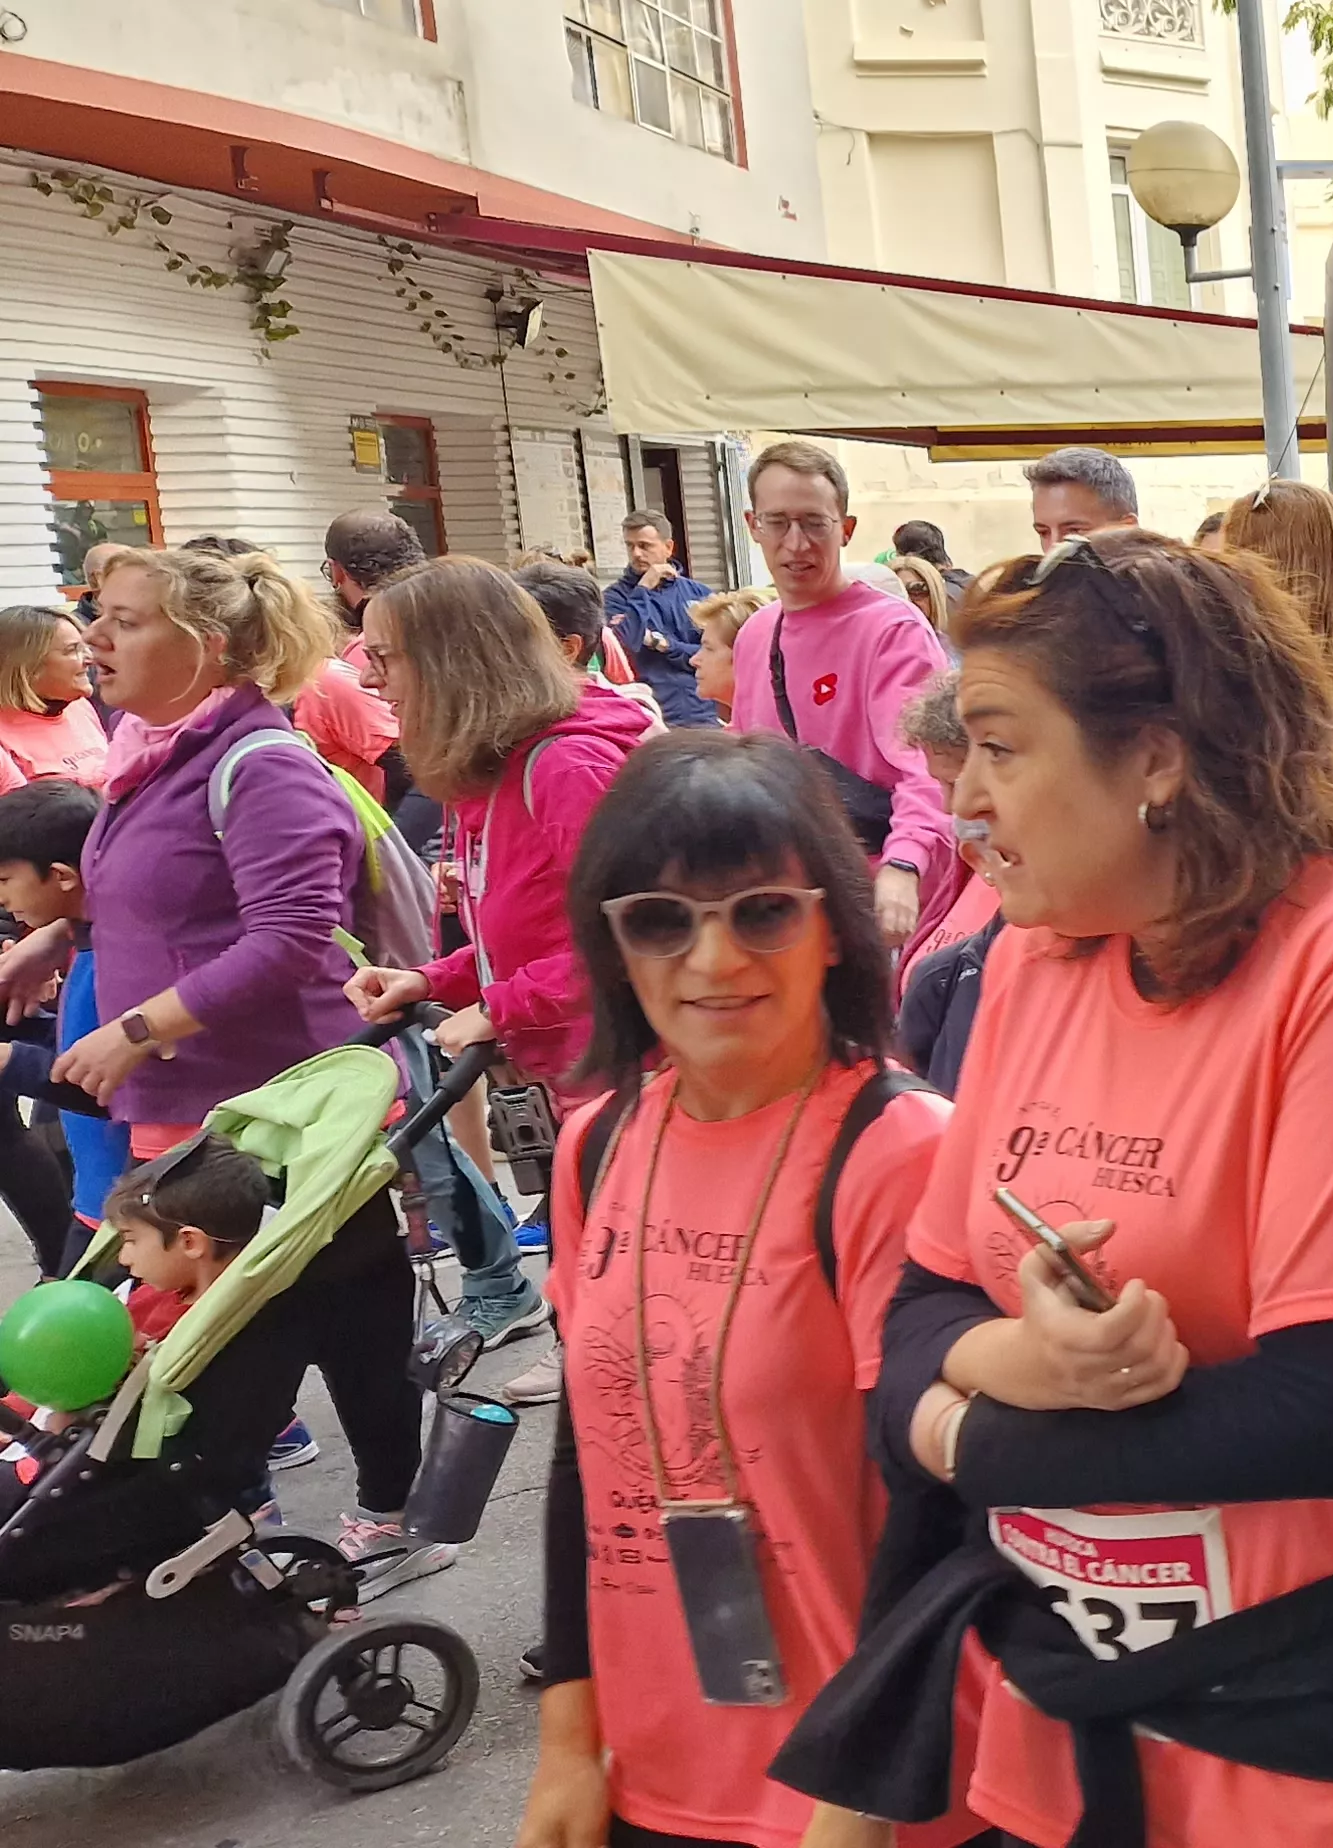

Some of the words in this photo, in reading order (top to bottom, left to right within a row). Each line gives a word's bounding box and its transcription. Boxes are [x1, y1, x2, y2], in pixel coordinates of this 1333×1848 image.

[1055, 1121, 1164, 1169] CÁNCER
[1092, 1166, 1177, 1198] HUESCA
[1085, 1558, 1195, 1585] CÁNCER
[9, 1623, 85, 1642] SNAP4
